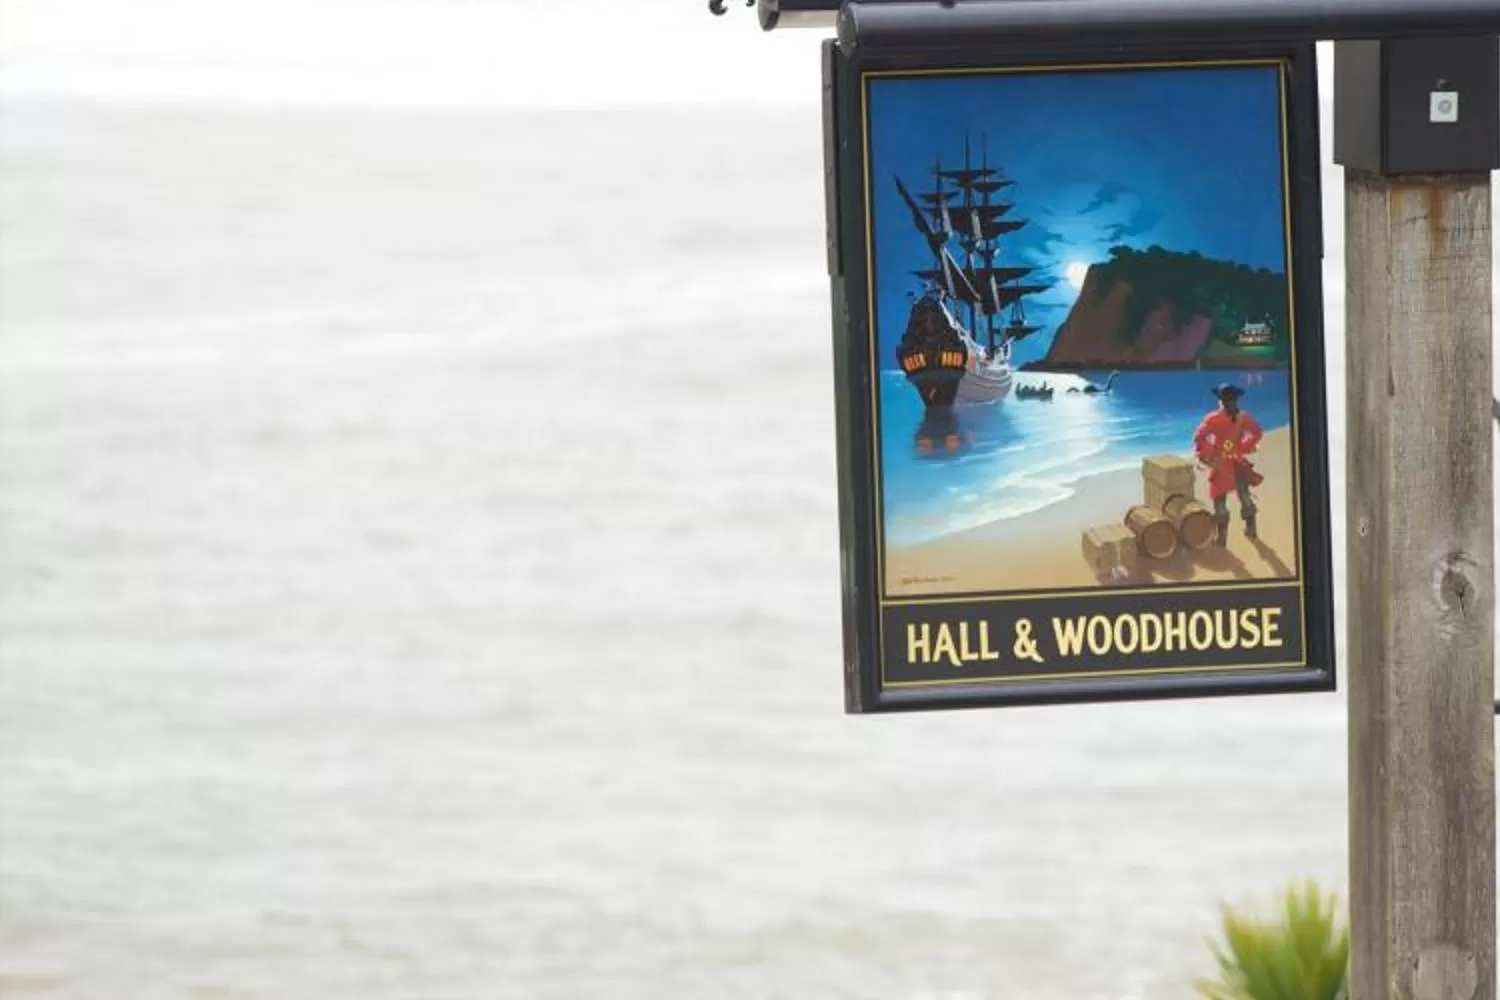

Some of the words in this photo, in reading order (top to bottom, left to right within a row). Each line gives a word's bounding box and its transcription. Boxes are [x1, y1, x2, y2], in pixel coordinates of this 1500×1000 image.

[905, 620, 999, 667] HALL
[1012, 618, 1045, 663] &
[1051, 607, 1284, 658] WOODHOUSE
